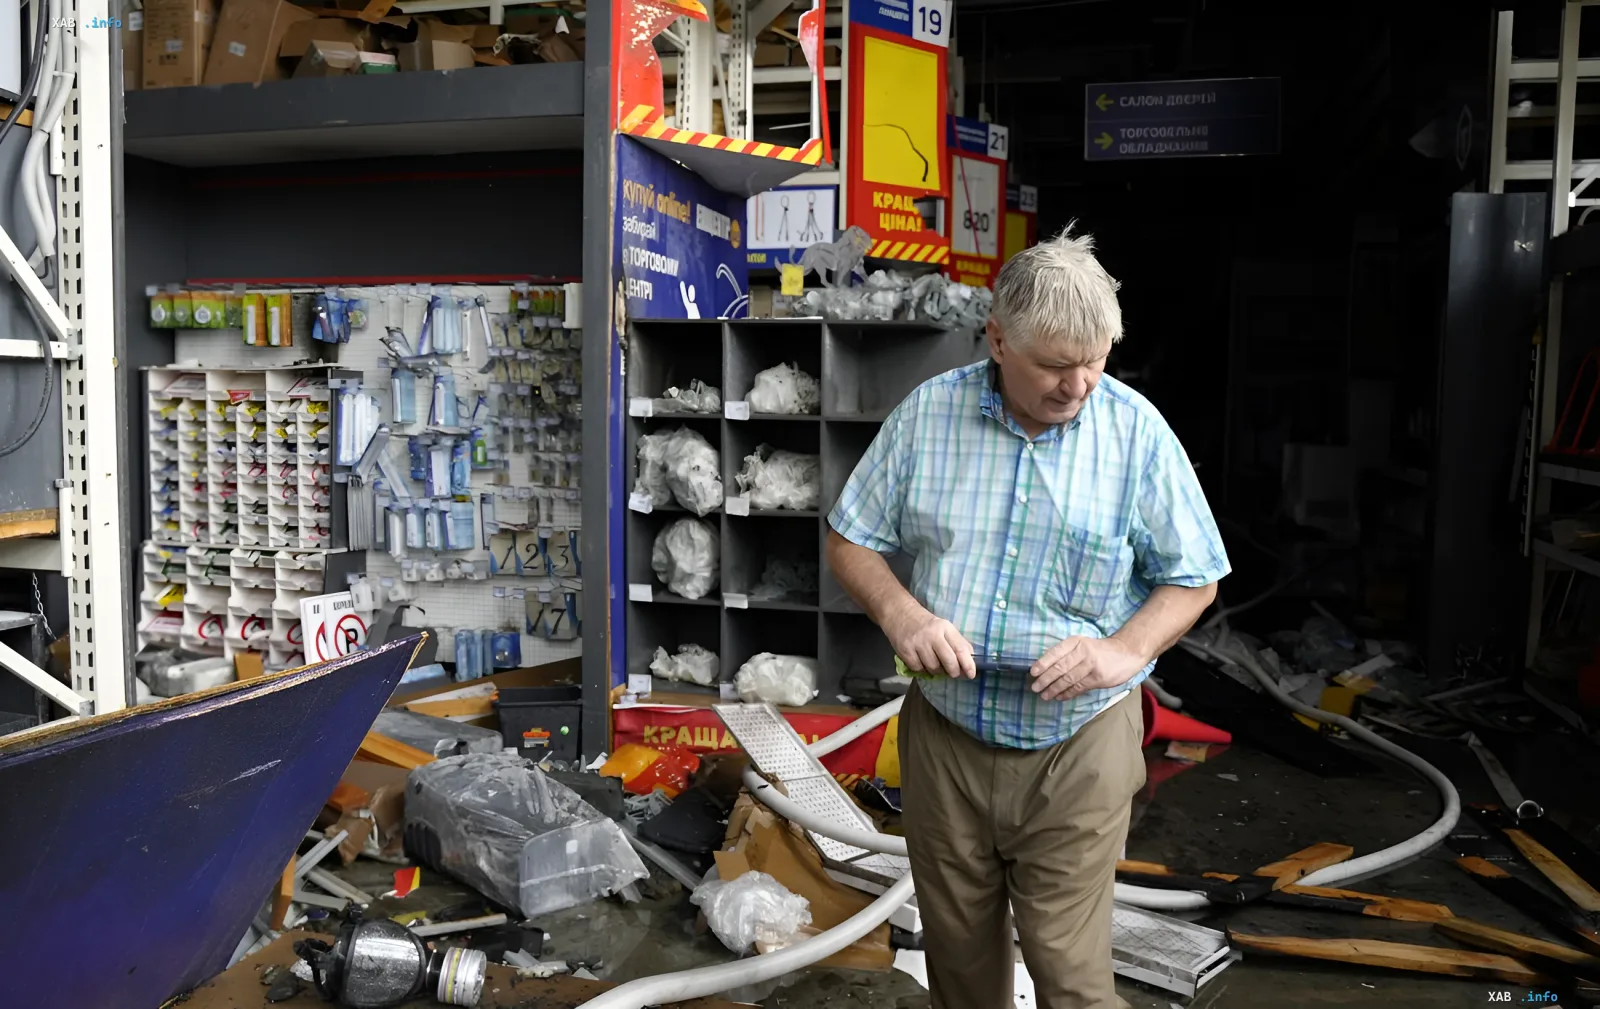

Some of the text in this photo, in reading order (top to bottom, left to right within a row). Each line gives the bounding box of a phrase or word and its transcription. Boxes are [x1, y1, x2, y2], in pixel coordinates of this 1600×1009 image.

[918, 6, 942, 36] 19
[990, 132, 1006, 153] 21
[1021, 191, 1035, 207] 23
[880, 212, 923, 232] ЦІНА!
[963, 210, 990, 233] 820
[523, 543, 539, 570] 2
[552, 545, 570, 570] 3
[551, 608, 567, 635] 7
[643, 725, 738, 750] КРАЩА
